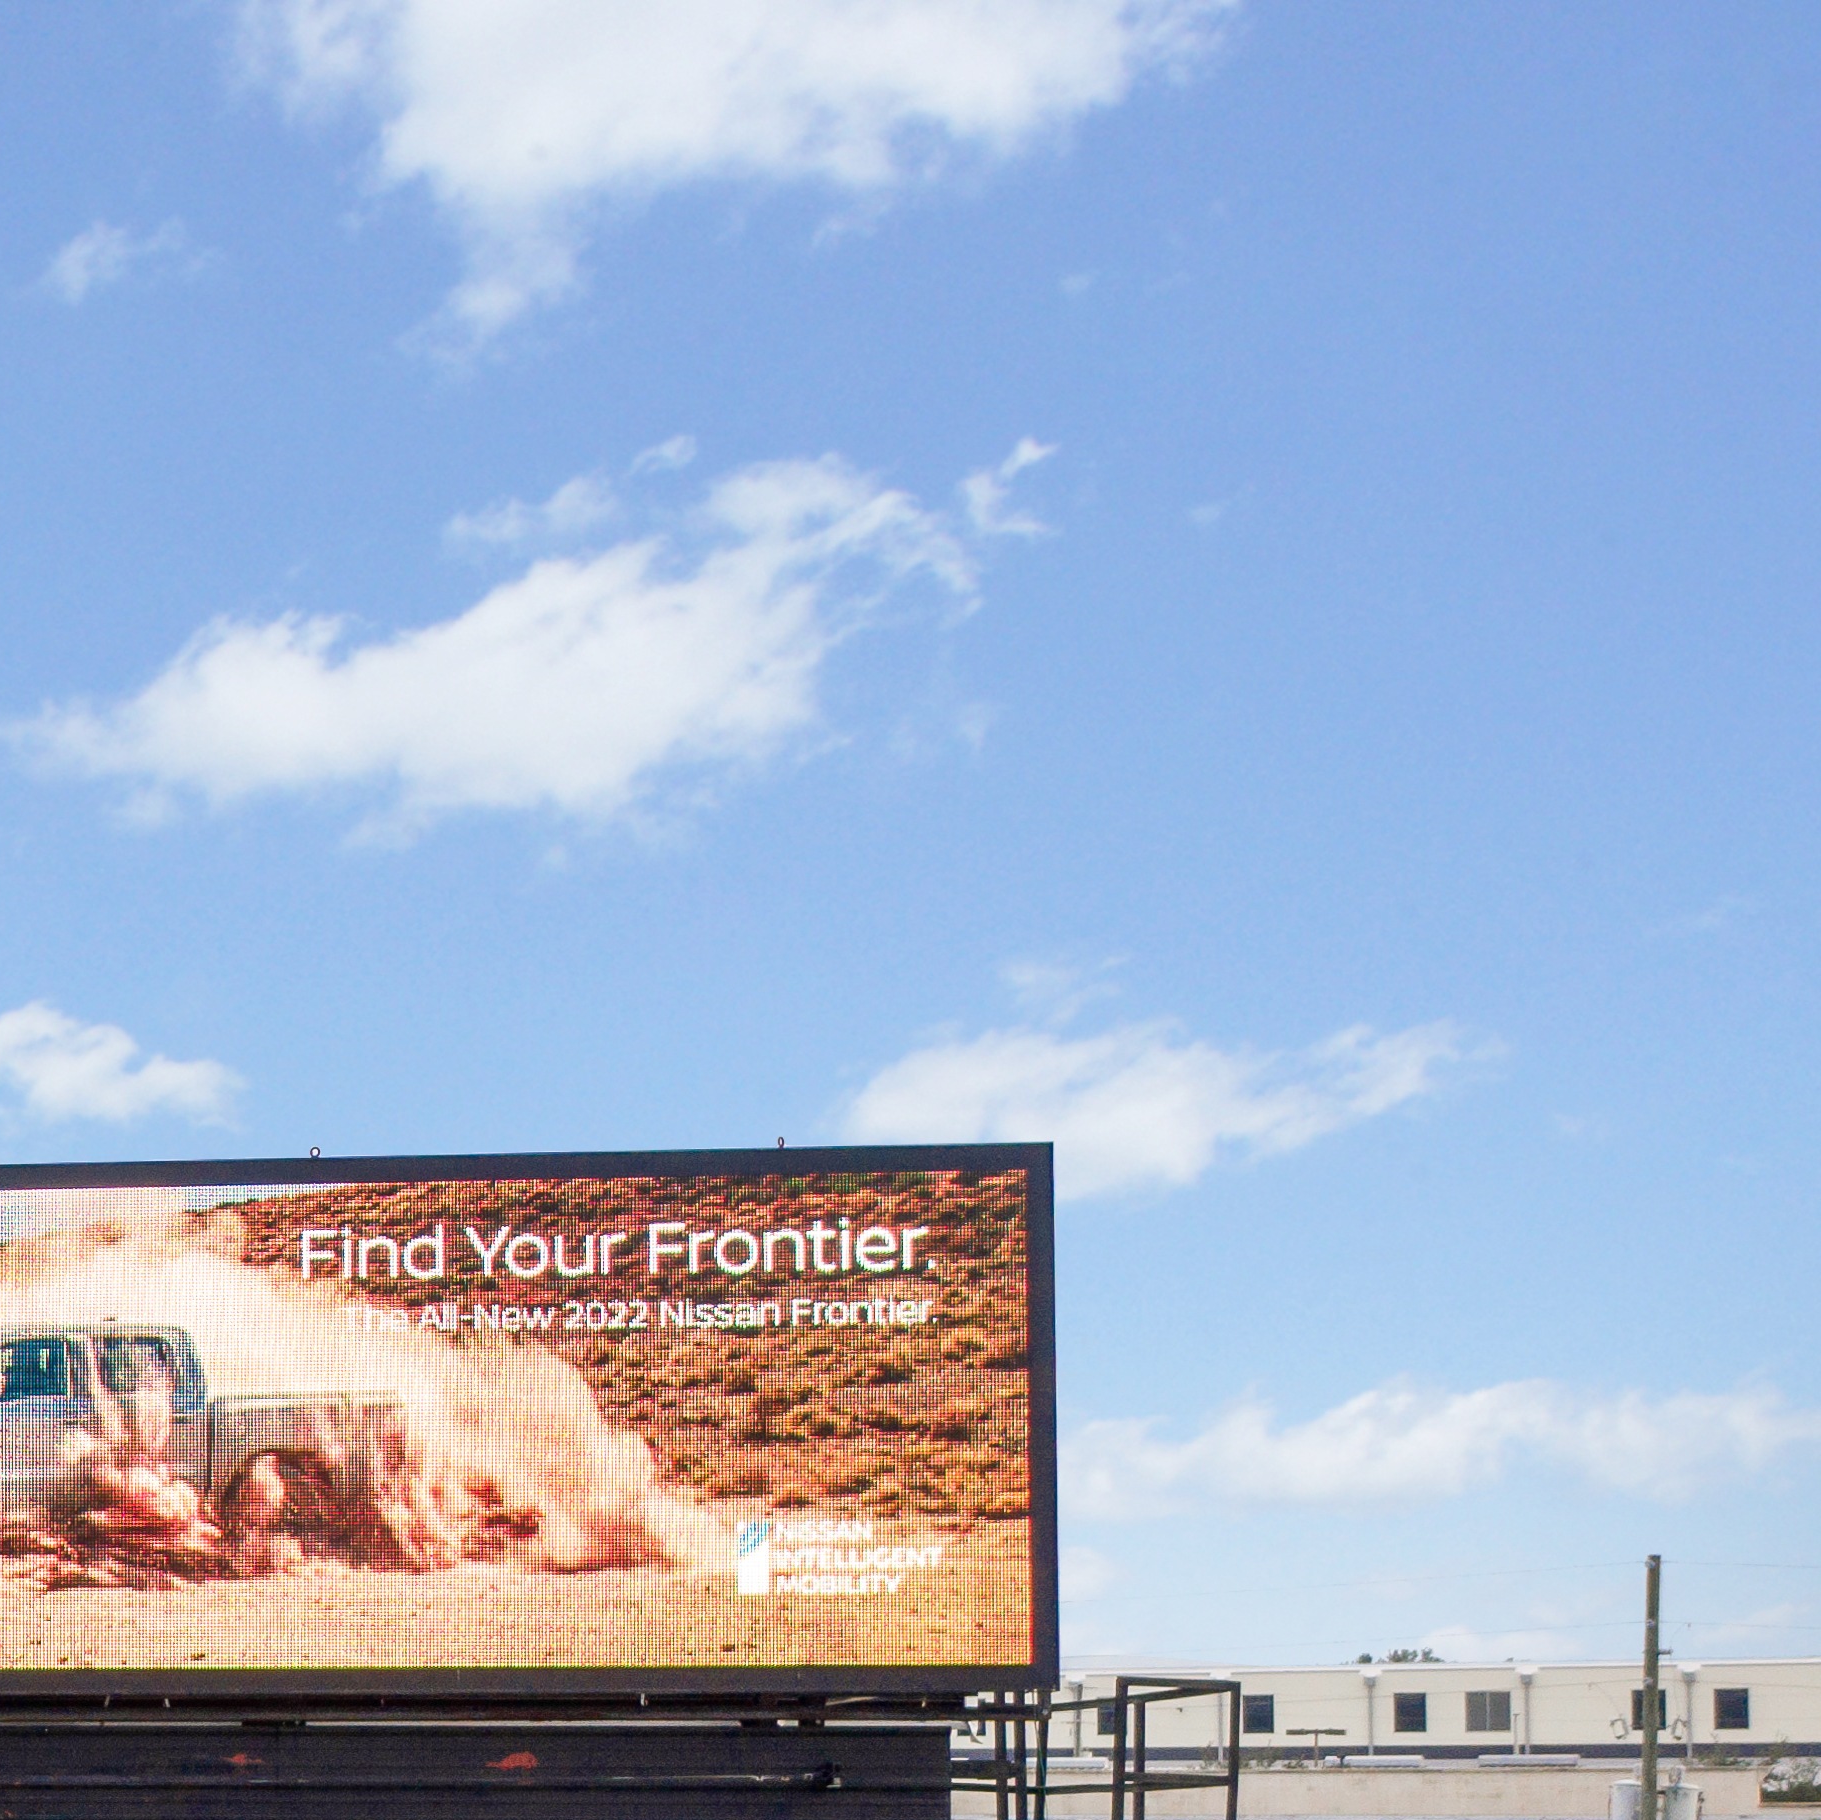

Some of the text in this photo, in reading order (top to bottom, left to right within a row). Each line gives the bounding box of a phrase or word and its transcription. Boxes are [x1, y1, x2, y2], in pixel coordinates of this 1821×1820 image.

[301, 1217, 935, 1280] Find Your Frontier.
[418, 1301, 557, 1331] All-New
[563, 1299, 647, 1330] 2022
[659, 1298, 779, 1328] Nissan
[791, 1298, 938, 1327] Frontier.
[777, 1520, 874, 1542] NISSAN
